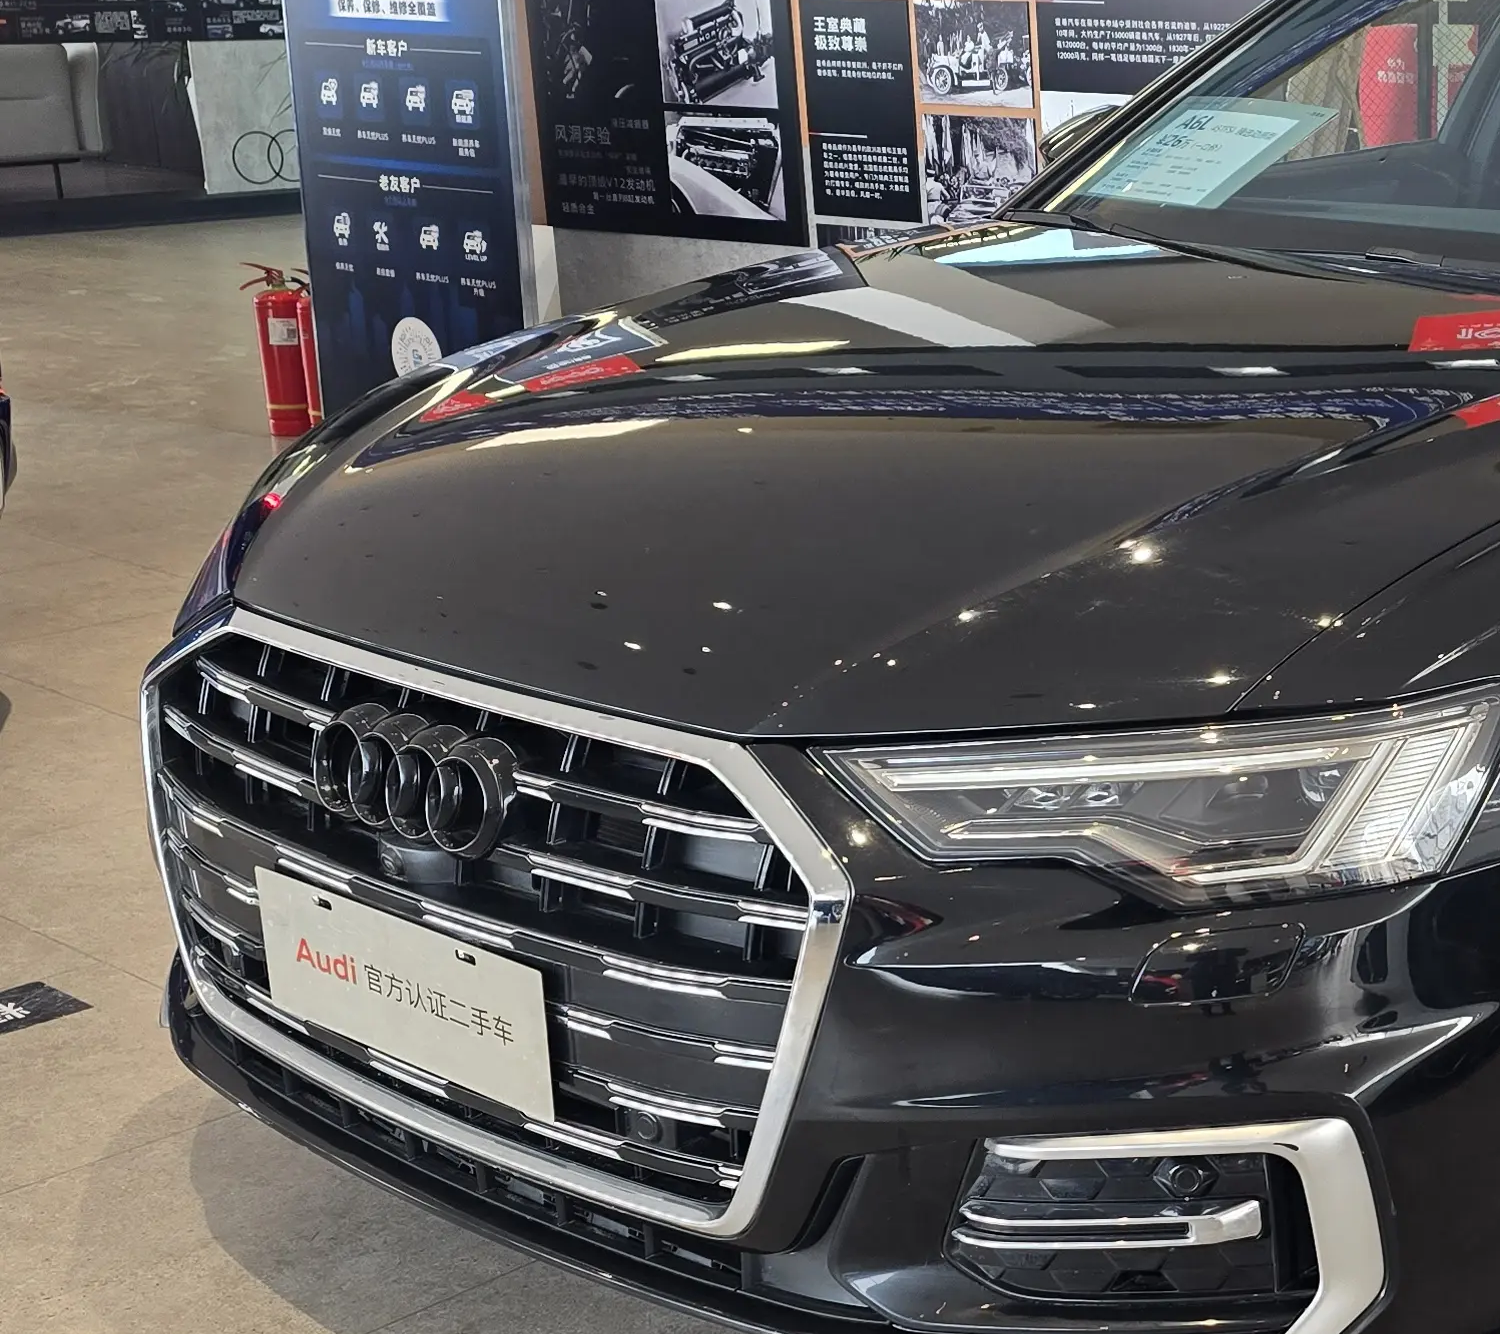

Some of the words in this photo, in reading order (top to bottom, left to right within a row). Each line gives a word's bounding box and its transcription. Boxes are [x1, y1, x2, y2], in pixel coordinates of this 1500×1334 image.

[813, 16, 867, 34] 王室典藏
[366, 38, 408, 57] 新车客户
[814, 34, 868, 53] 极致尊崇
[1175, 114, 1215, 131] A6L
[555, 124, 612, 145] 风洞实验
[378, 174, 421, 194] 老友客户
[295, 937, 358, 985] Audi
[363, 962, 515, 1046] 官方认证二手车
